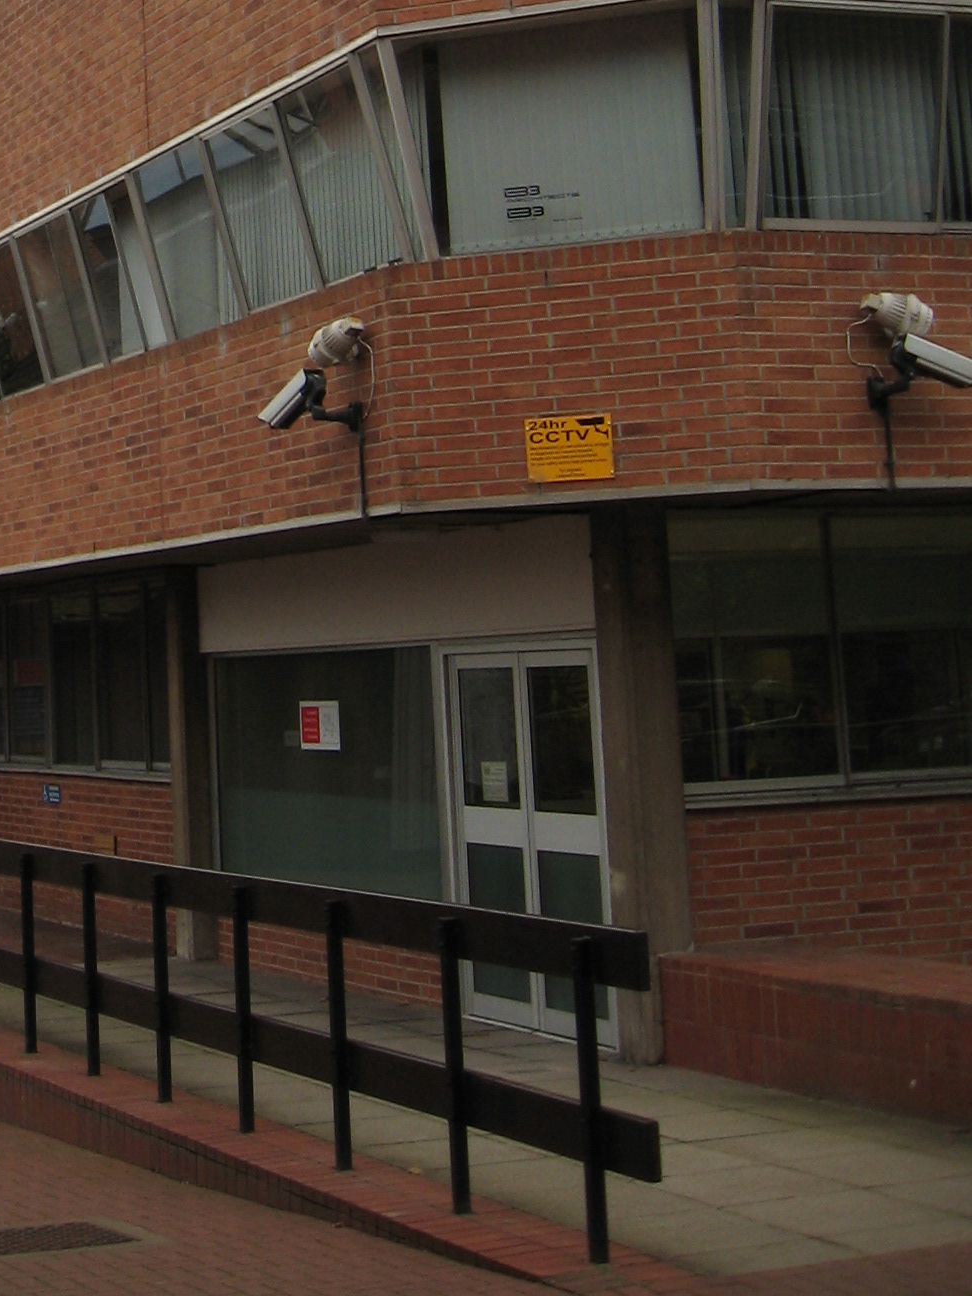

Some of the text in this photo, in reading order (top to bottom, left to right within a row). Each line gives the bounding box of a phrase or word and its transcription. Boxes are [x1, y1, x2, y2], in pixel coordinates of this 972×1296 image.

[504, 185, 540, 198] B3
[507, 205, 544, 219] B3
[528, 419, 568, 431] 24hr
[529, 428, 590, 444] CCTV
